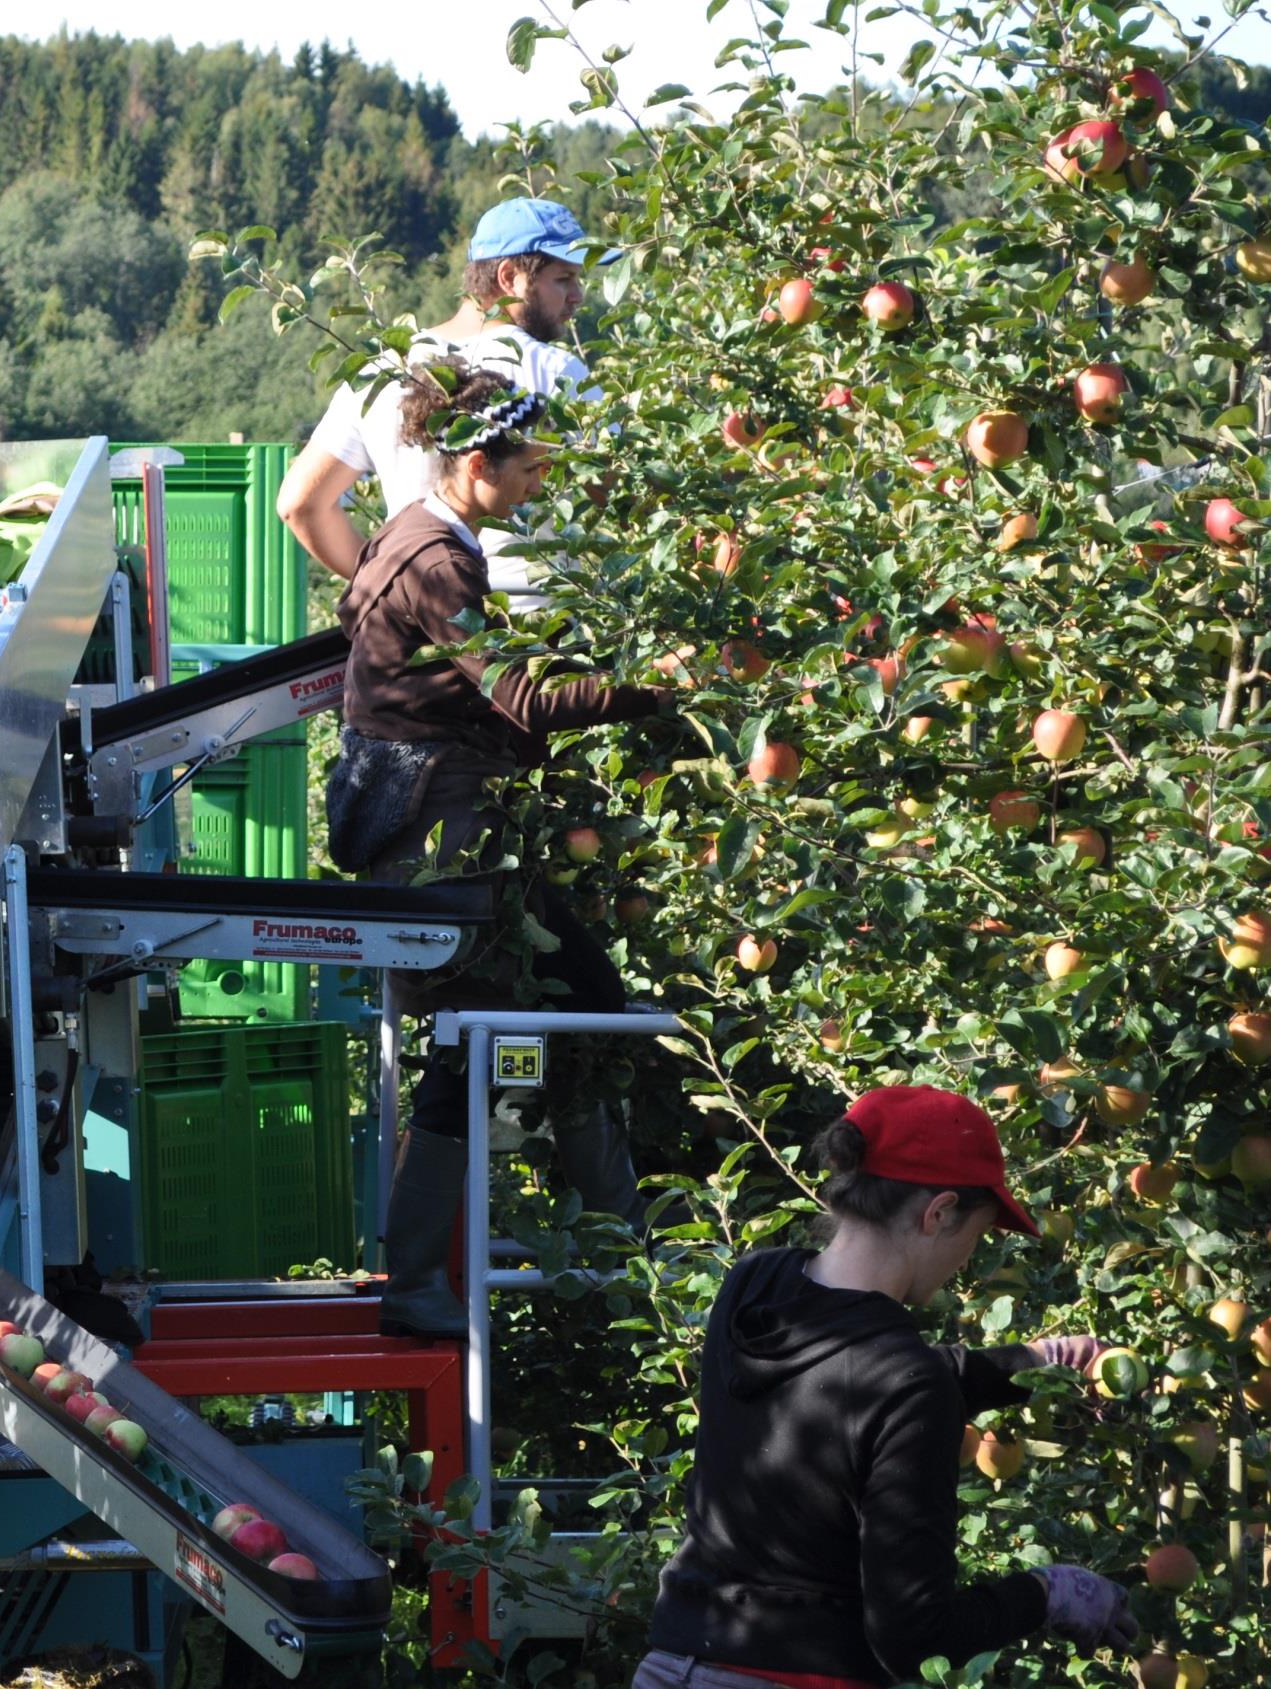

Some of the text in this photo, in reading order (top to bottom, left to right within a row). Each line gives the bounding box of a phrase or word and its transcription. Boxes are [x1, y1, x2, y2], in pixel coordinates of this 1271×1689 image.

[289, 670, 345, 699] Frum
[253, 920, 356, 939] Frumaco
[324, 937, 363, 946] europe
